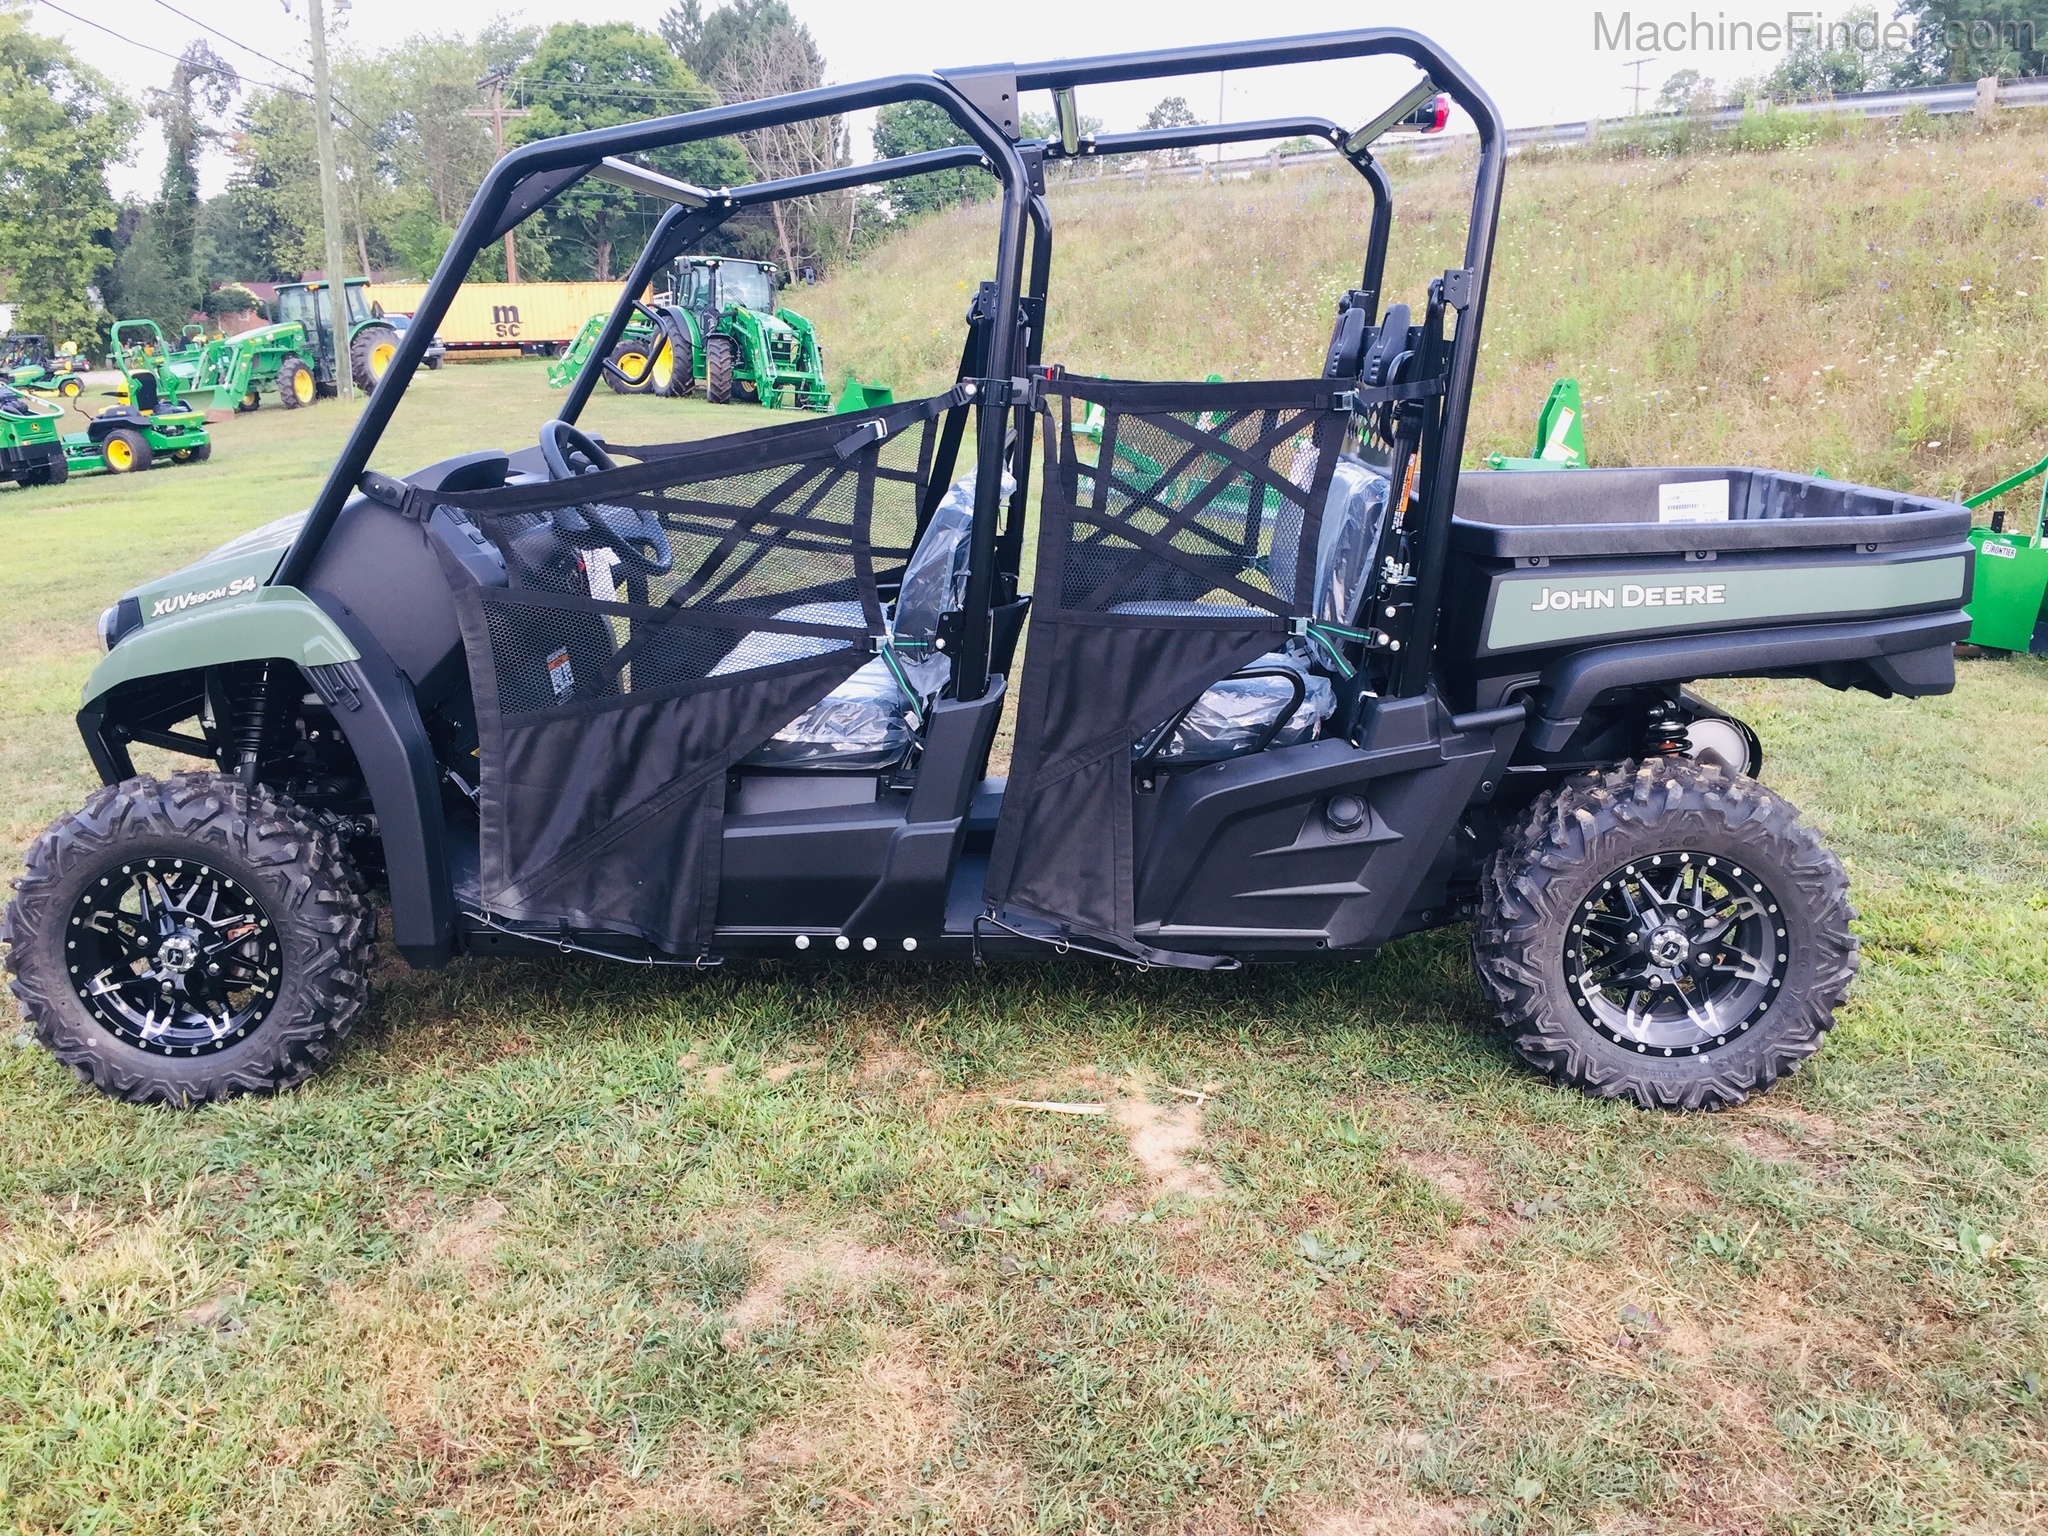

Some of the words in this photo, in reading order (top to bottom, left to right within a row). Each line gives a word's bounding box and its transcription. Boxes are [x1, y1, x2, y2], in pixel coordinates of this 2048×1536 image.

[1983, 541, 2015, 557] FRONTIER
[150, 587, 227, 617] XUV590M
[228, 576, 256, 596] S4
[1531, 587, 1615, 611] JOHN
[1621, 584, 1726, 607] DEERE
